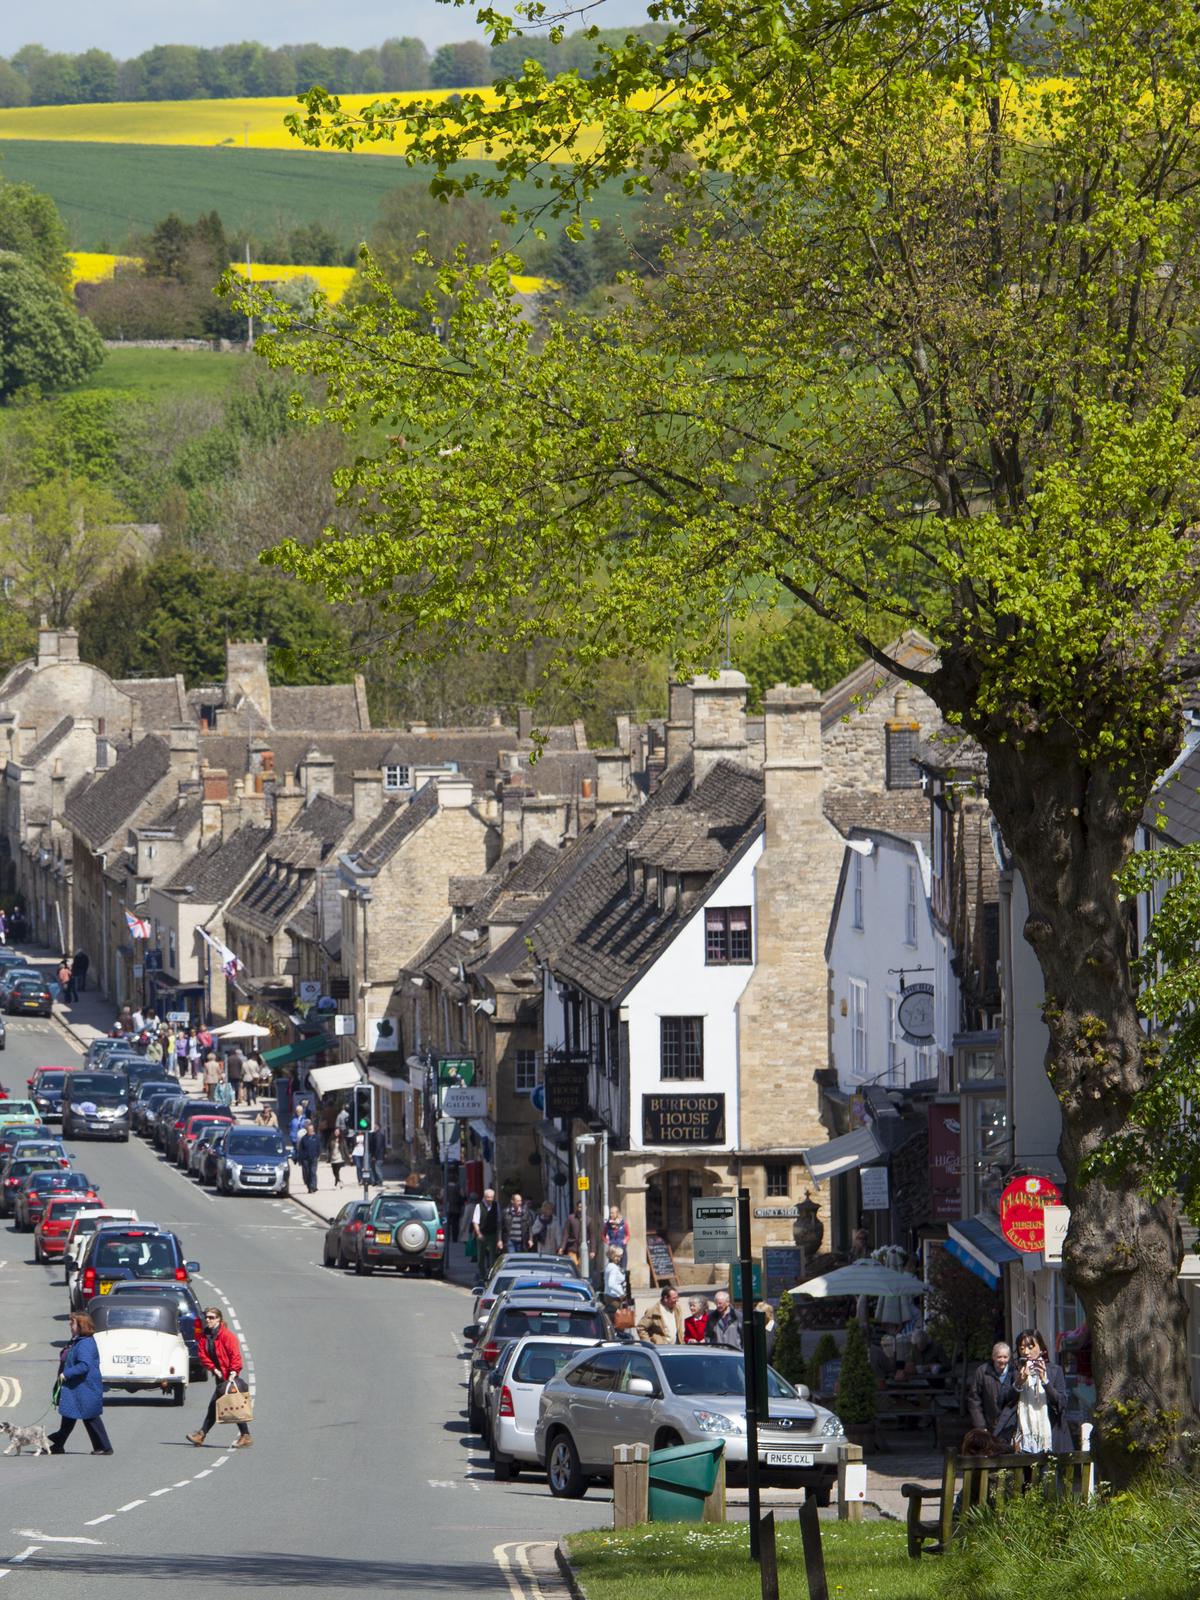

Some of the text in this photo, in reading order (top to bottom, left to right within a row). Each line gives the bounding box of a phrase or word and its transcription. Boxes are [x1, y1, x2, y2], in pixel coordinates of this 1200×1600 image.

[651, 1098, 718, 1111] BURFORD
[660, 1113, 710, 1125] HOUSE
[661, 1127, 709, 1139] HOTEL
[770, 1454, 811, 1464] RN55 CXL
